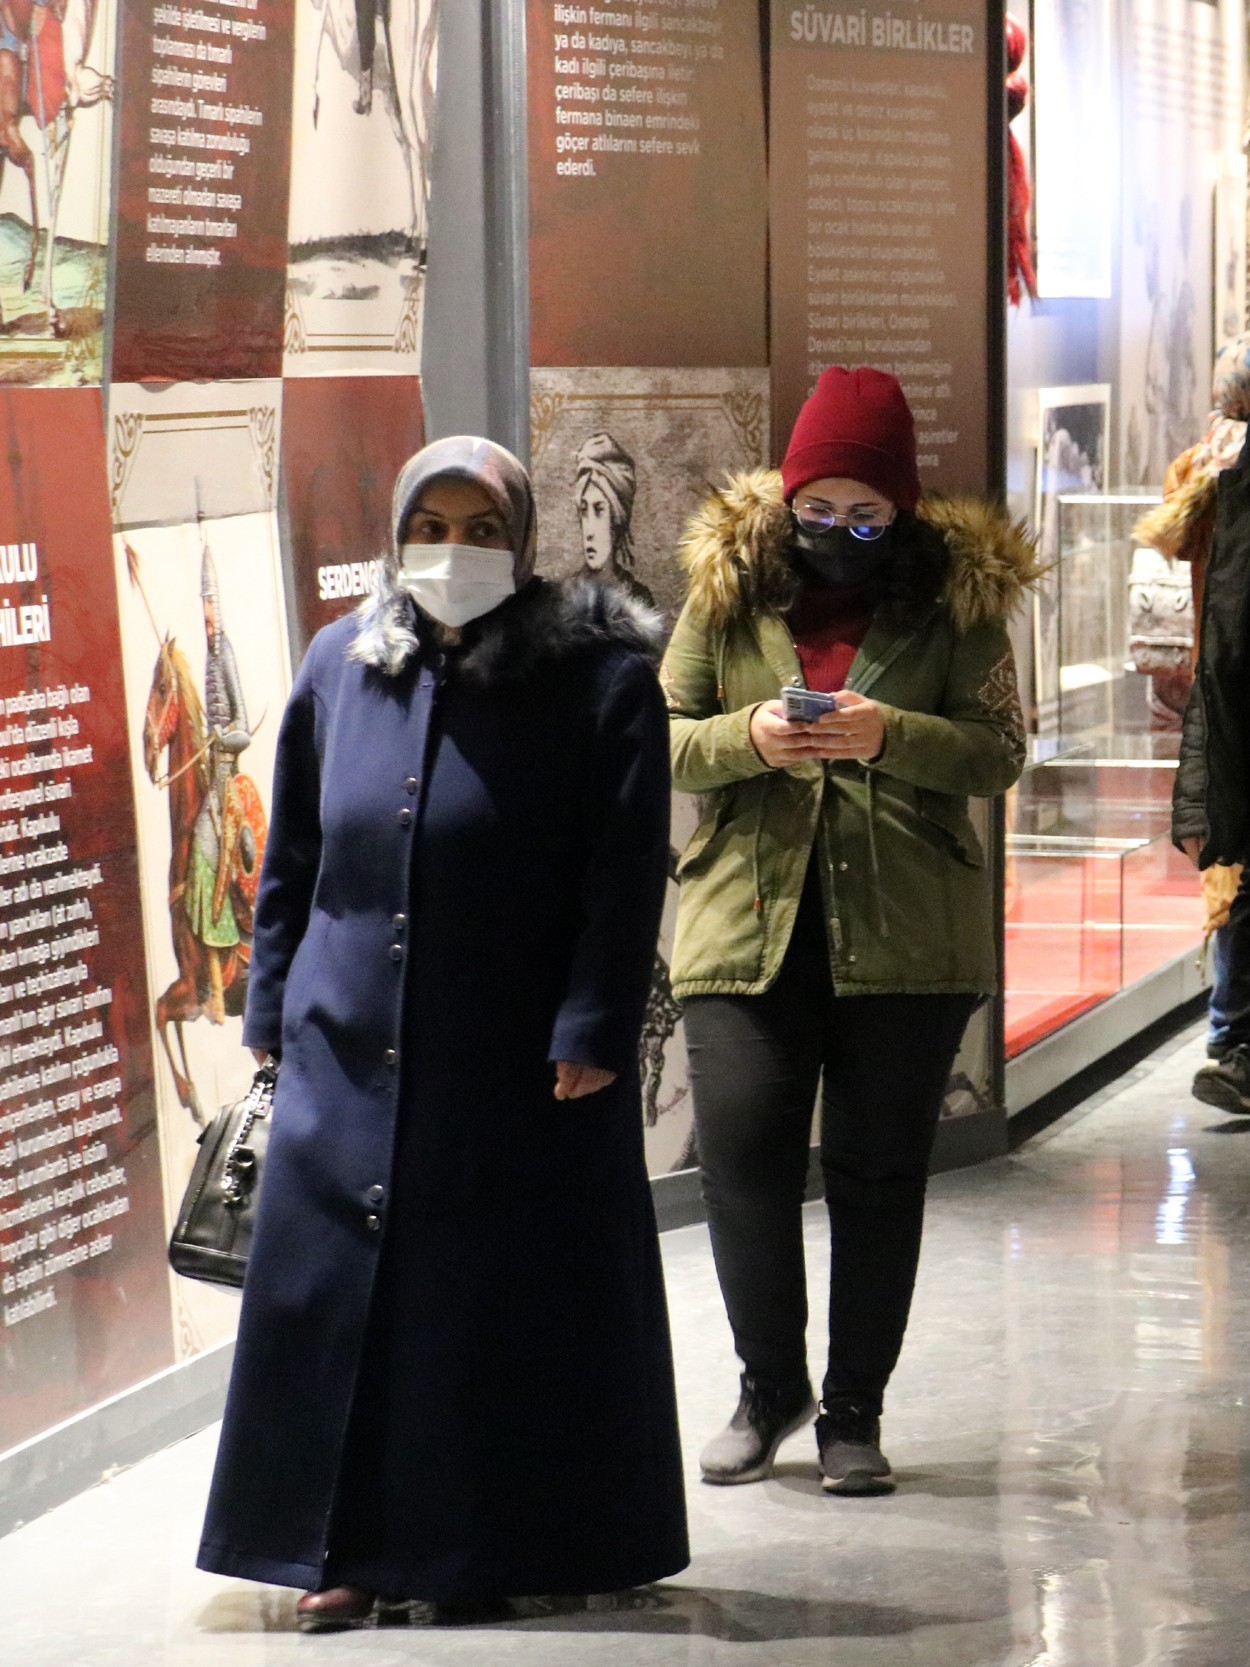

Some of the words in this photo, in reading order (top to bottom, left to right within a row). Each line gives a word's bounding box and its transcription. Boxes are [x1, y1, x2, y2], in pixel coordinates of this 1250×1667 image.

[554, 4, 587, 25] ilişkin
[589, 8, 632, 27] fermanı
[635, 11, 658, 31] ilgili
[790, 4, 866, 46] SÜVARİ
[872, 10, 974, 54] BİRLİKLER
[554, 34, 568, 50] ya
[571, 32, 586, 48] da
[588, 32, 628, 54] kadıya,
[555, 56, 579, 74] kadı
[582, 58, 606, 78] ilgili
[608, 60, 665, 81] çeribaşına
[555, 82, 600, 103] çeribaşı
[602, 84, 617, 102] da
[620, 86, 654, 103] sefere
[555, 106, 602, 126] fermana
[605, 109, 643, 127] binaen
[556, 132, 590, 153] göçer
[592, 134, 637, 152] atlılarını
[640, 138, 674, 154] sefere
[556, 158, 596, 176] ederdi.
